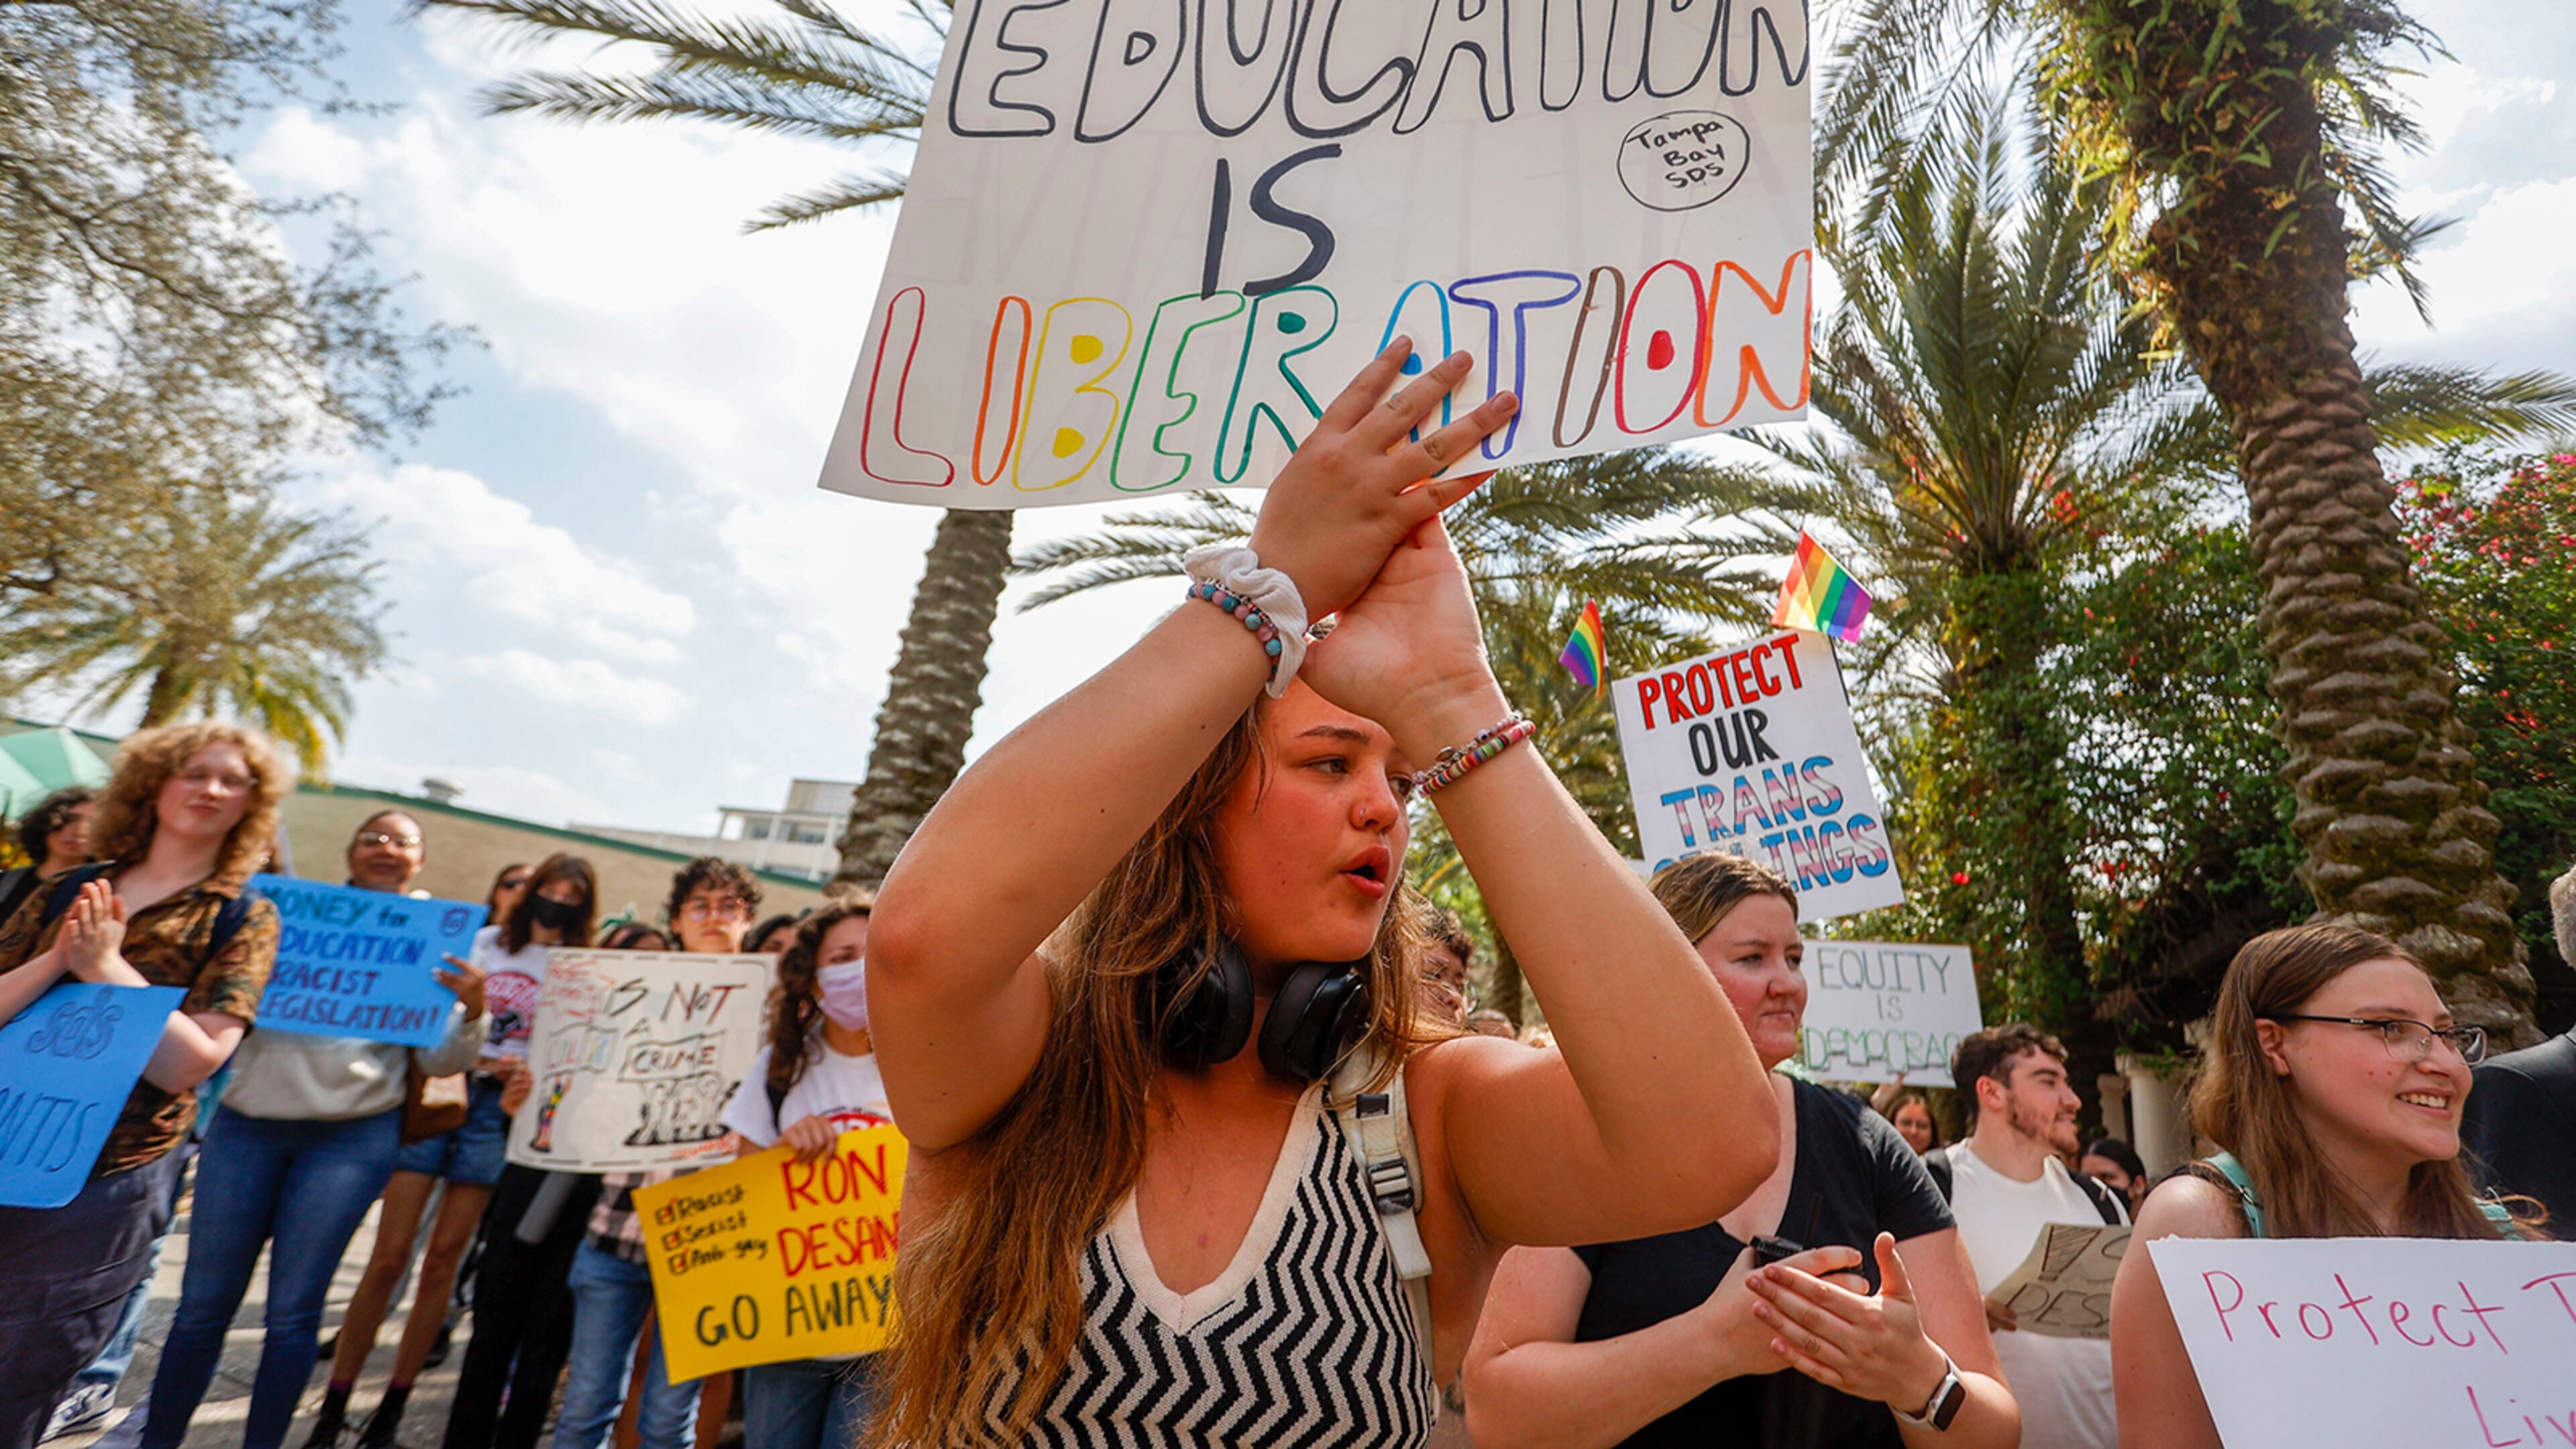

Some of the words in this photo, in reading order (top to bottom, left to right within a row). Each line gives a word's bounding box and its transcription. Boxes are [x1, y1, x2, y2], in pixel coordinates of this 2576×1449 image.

[1626, 121, 1725, 150] Tampa
[1663, 143, 1725, 166] Bay
[1665, 162, 1725, 189] SDS
[1200, 143, 1342, 300] IS
[859, 249, 1813, 493] LIBERATION
[1637, 633, 1805, 731] PROTECT
[1688, 707, 1780, 777] OUR
[1660, 755, 1844, 848] TRANS
[377, 904, 411, 928] for
[278, 925, 427, 965] DUCATION
[1817, 947, 1951, 994] EQUITY
[259, 991, 440, 1032] EGISLATION!
[1876, 993, 1904, 1021] IS
[633, 1044, 716, 1074] CRIME
[780, 1143, 888, 1212] RON
[776, 1212, 900, 1278] DESAN
[695, 1293, 760, 1348] GO
[785, 1273, 894, 1338] AWAY
[2202, 1270, 2508, 1355] Protect
